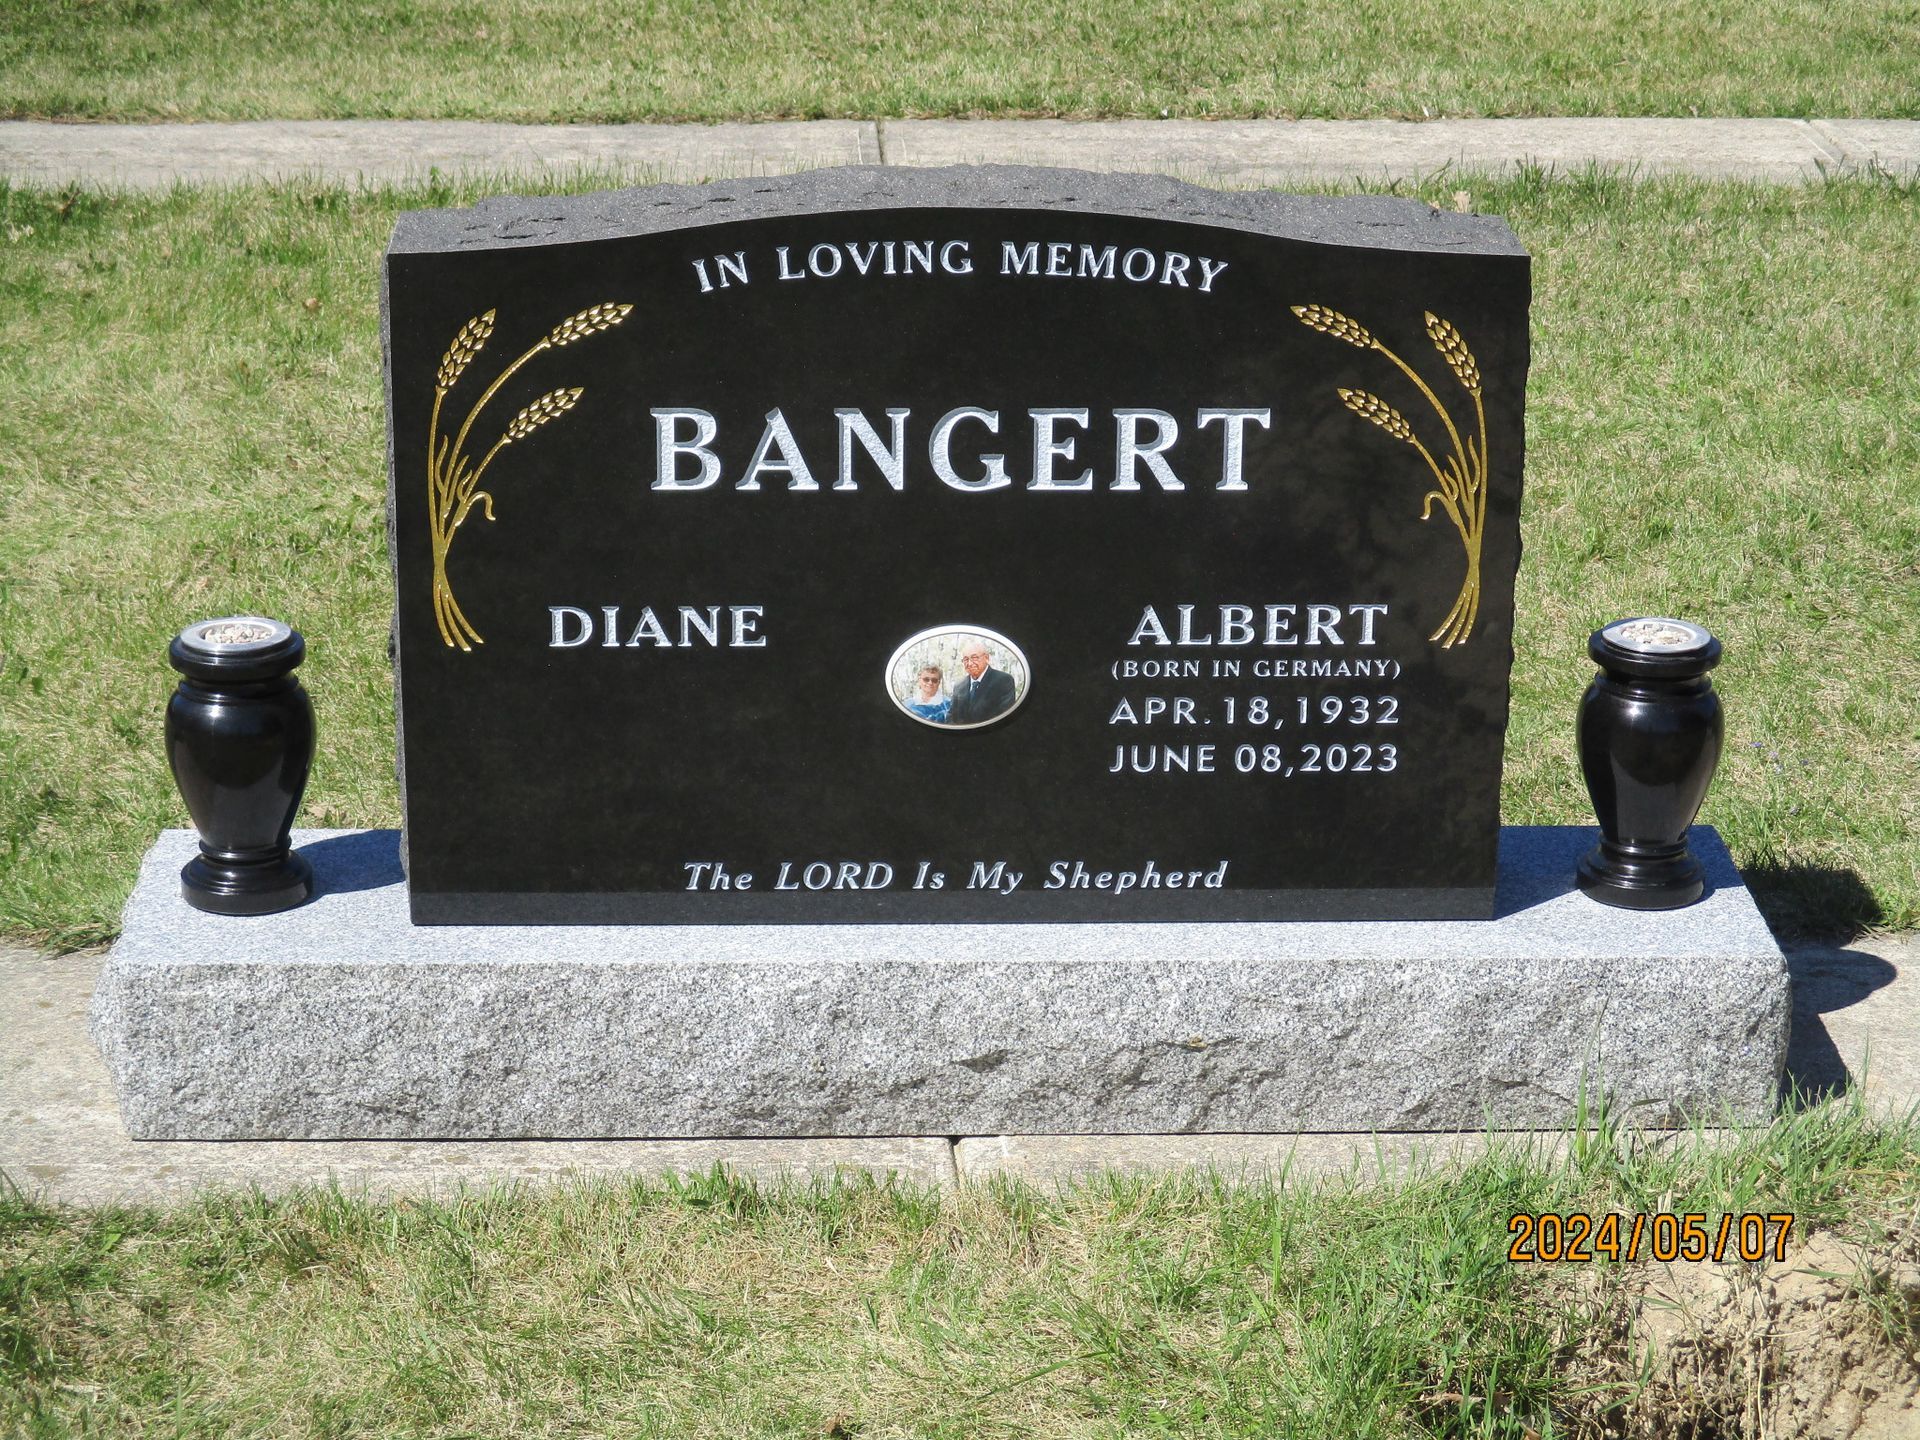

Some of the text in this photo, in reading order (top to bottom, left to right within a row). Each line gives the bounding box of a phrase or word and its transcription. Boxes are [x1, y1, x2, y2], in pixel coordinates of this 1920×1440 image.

[692, 240, 1228, 293] IN LOVING MEMORY
[650, 406, 1273, 492] BANGERT
[548, 605, 767, 648] DIANE
[1127, 604, 1389, 646] ALBERT
[1111, 659, 1401, 680] (BORN IN GERMANY)
[1109, 696, 1212, 725] APR.
[1109, 744, 1216, 773] JUNE
[683, 860, 1229, 896] The LORD Is My Shepherd
